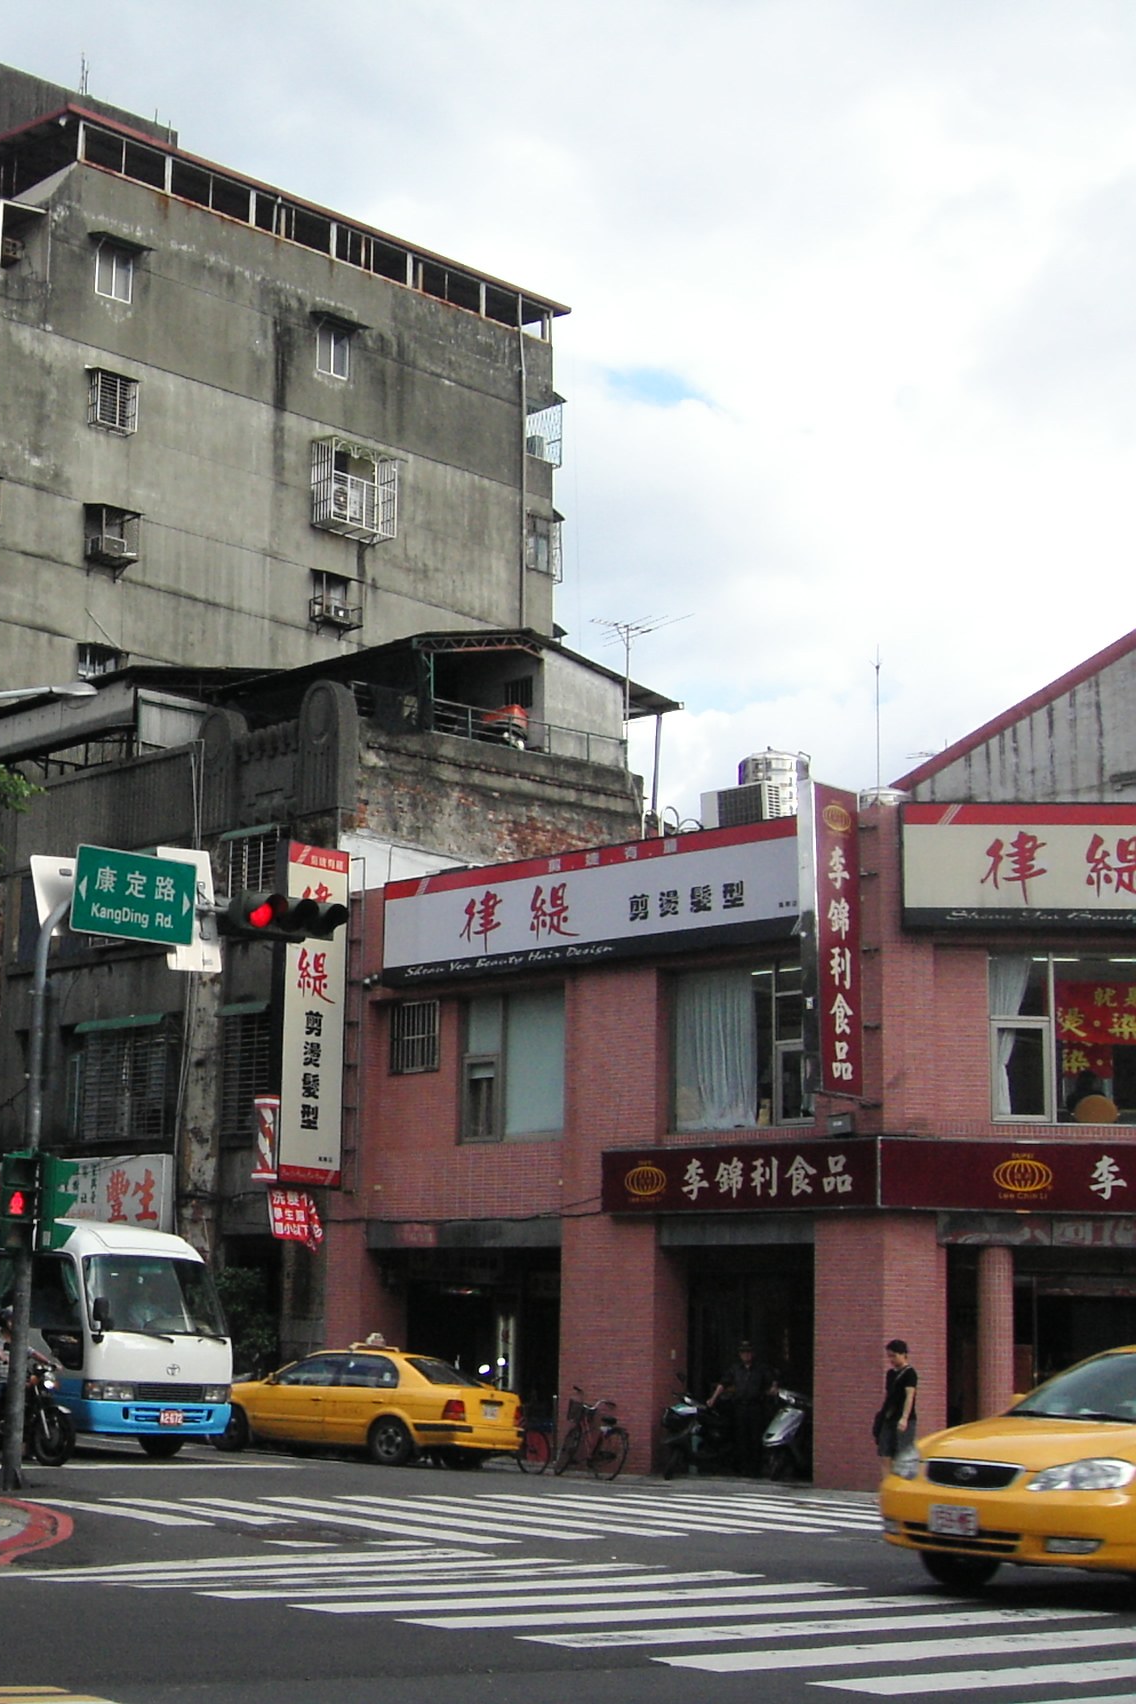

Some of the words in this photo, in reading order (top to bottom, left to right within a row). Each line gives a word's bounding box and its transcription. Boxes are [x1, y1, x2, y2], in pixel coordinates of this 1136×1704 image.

[95, 866, 176, 903] 康定路
[629, 880, 745, 921] 剪燙髮型
[91, 903, 149, 928] KangDing
[155, 912, 174, 928] Rd.
[459, 883, 580, 953] 律緹
[528, 949, 562, 961] Hair
[566, 945, 614, 958] Design
[827, 846, 853, 1080] 李錦利食品
[301, 1010, 323, 1131] 剪燙髮型
[681, 1154, 853, 1200] 李錦利食品
[1089, 1155, 1128, 1200] 李
